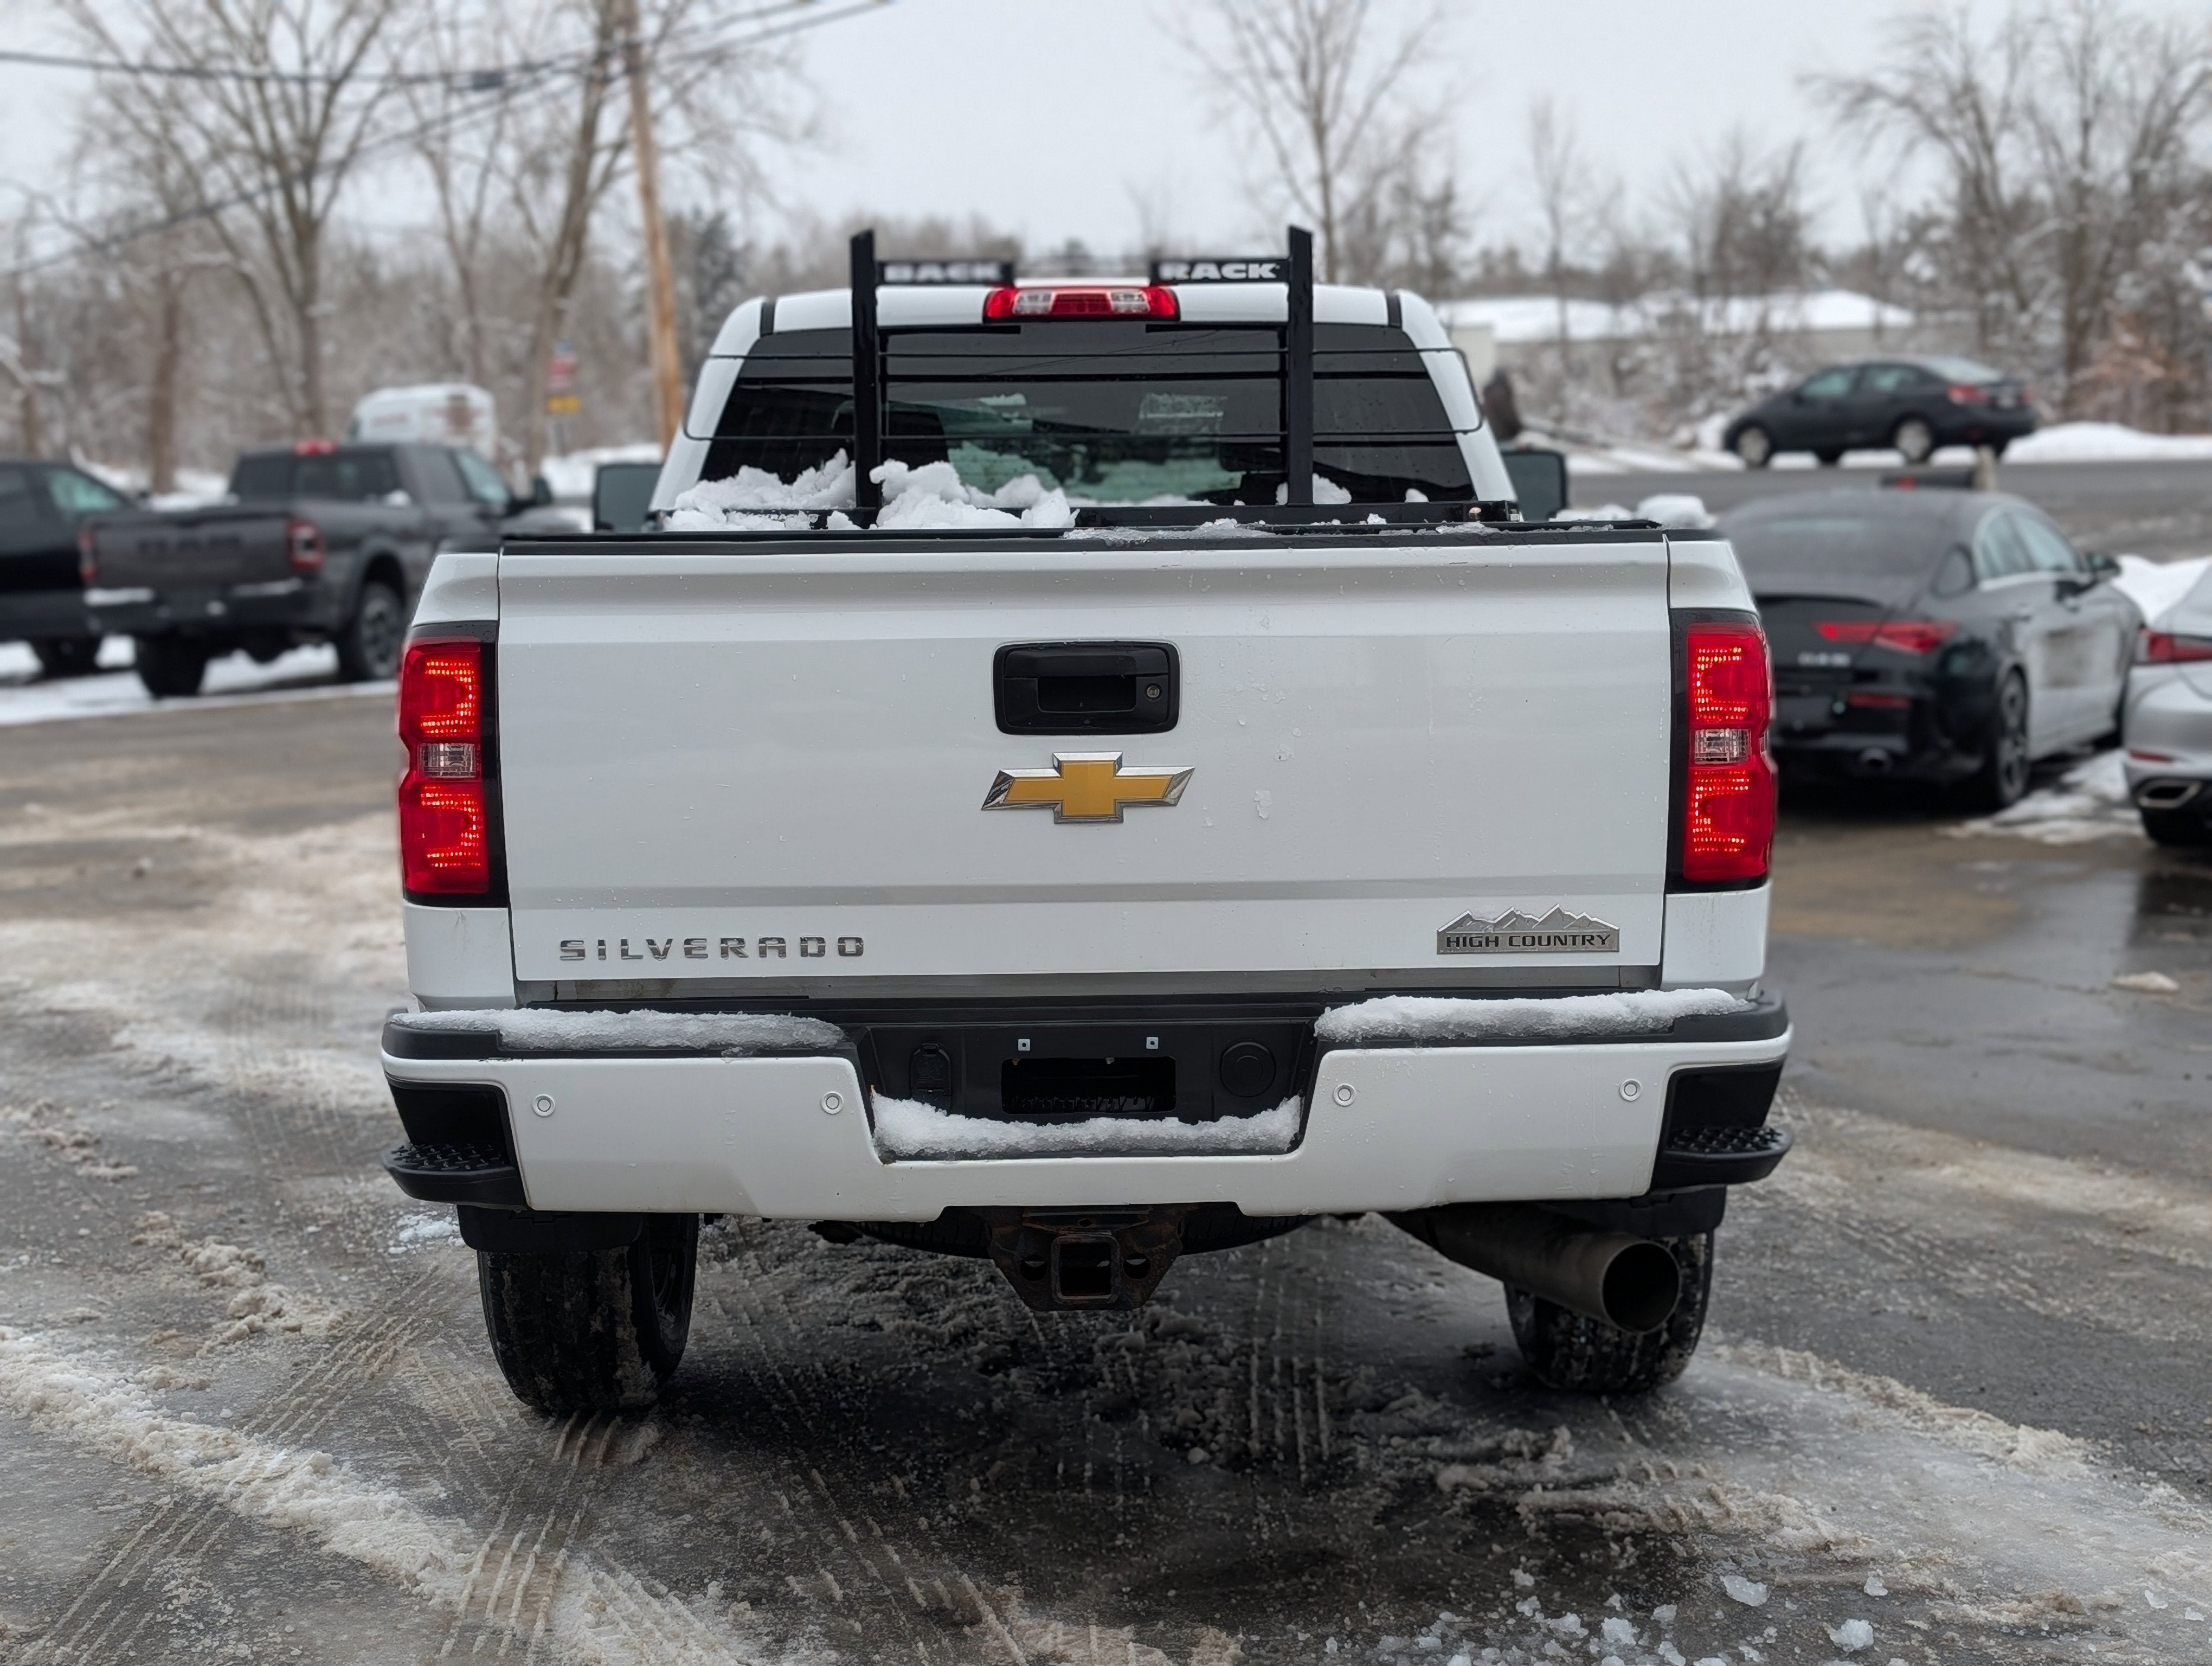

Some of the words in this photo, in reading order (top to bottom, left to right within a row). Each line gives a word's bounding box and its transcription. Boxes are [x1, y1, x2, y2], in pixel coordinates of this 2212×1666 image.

[1159, 262, 1277, 280] RACK
[560, 935, 864, 960] SILVERADO
[1446, 935, 1500, 948] HIGH
[1508, 934, 1611, 947] COUNTRY
